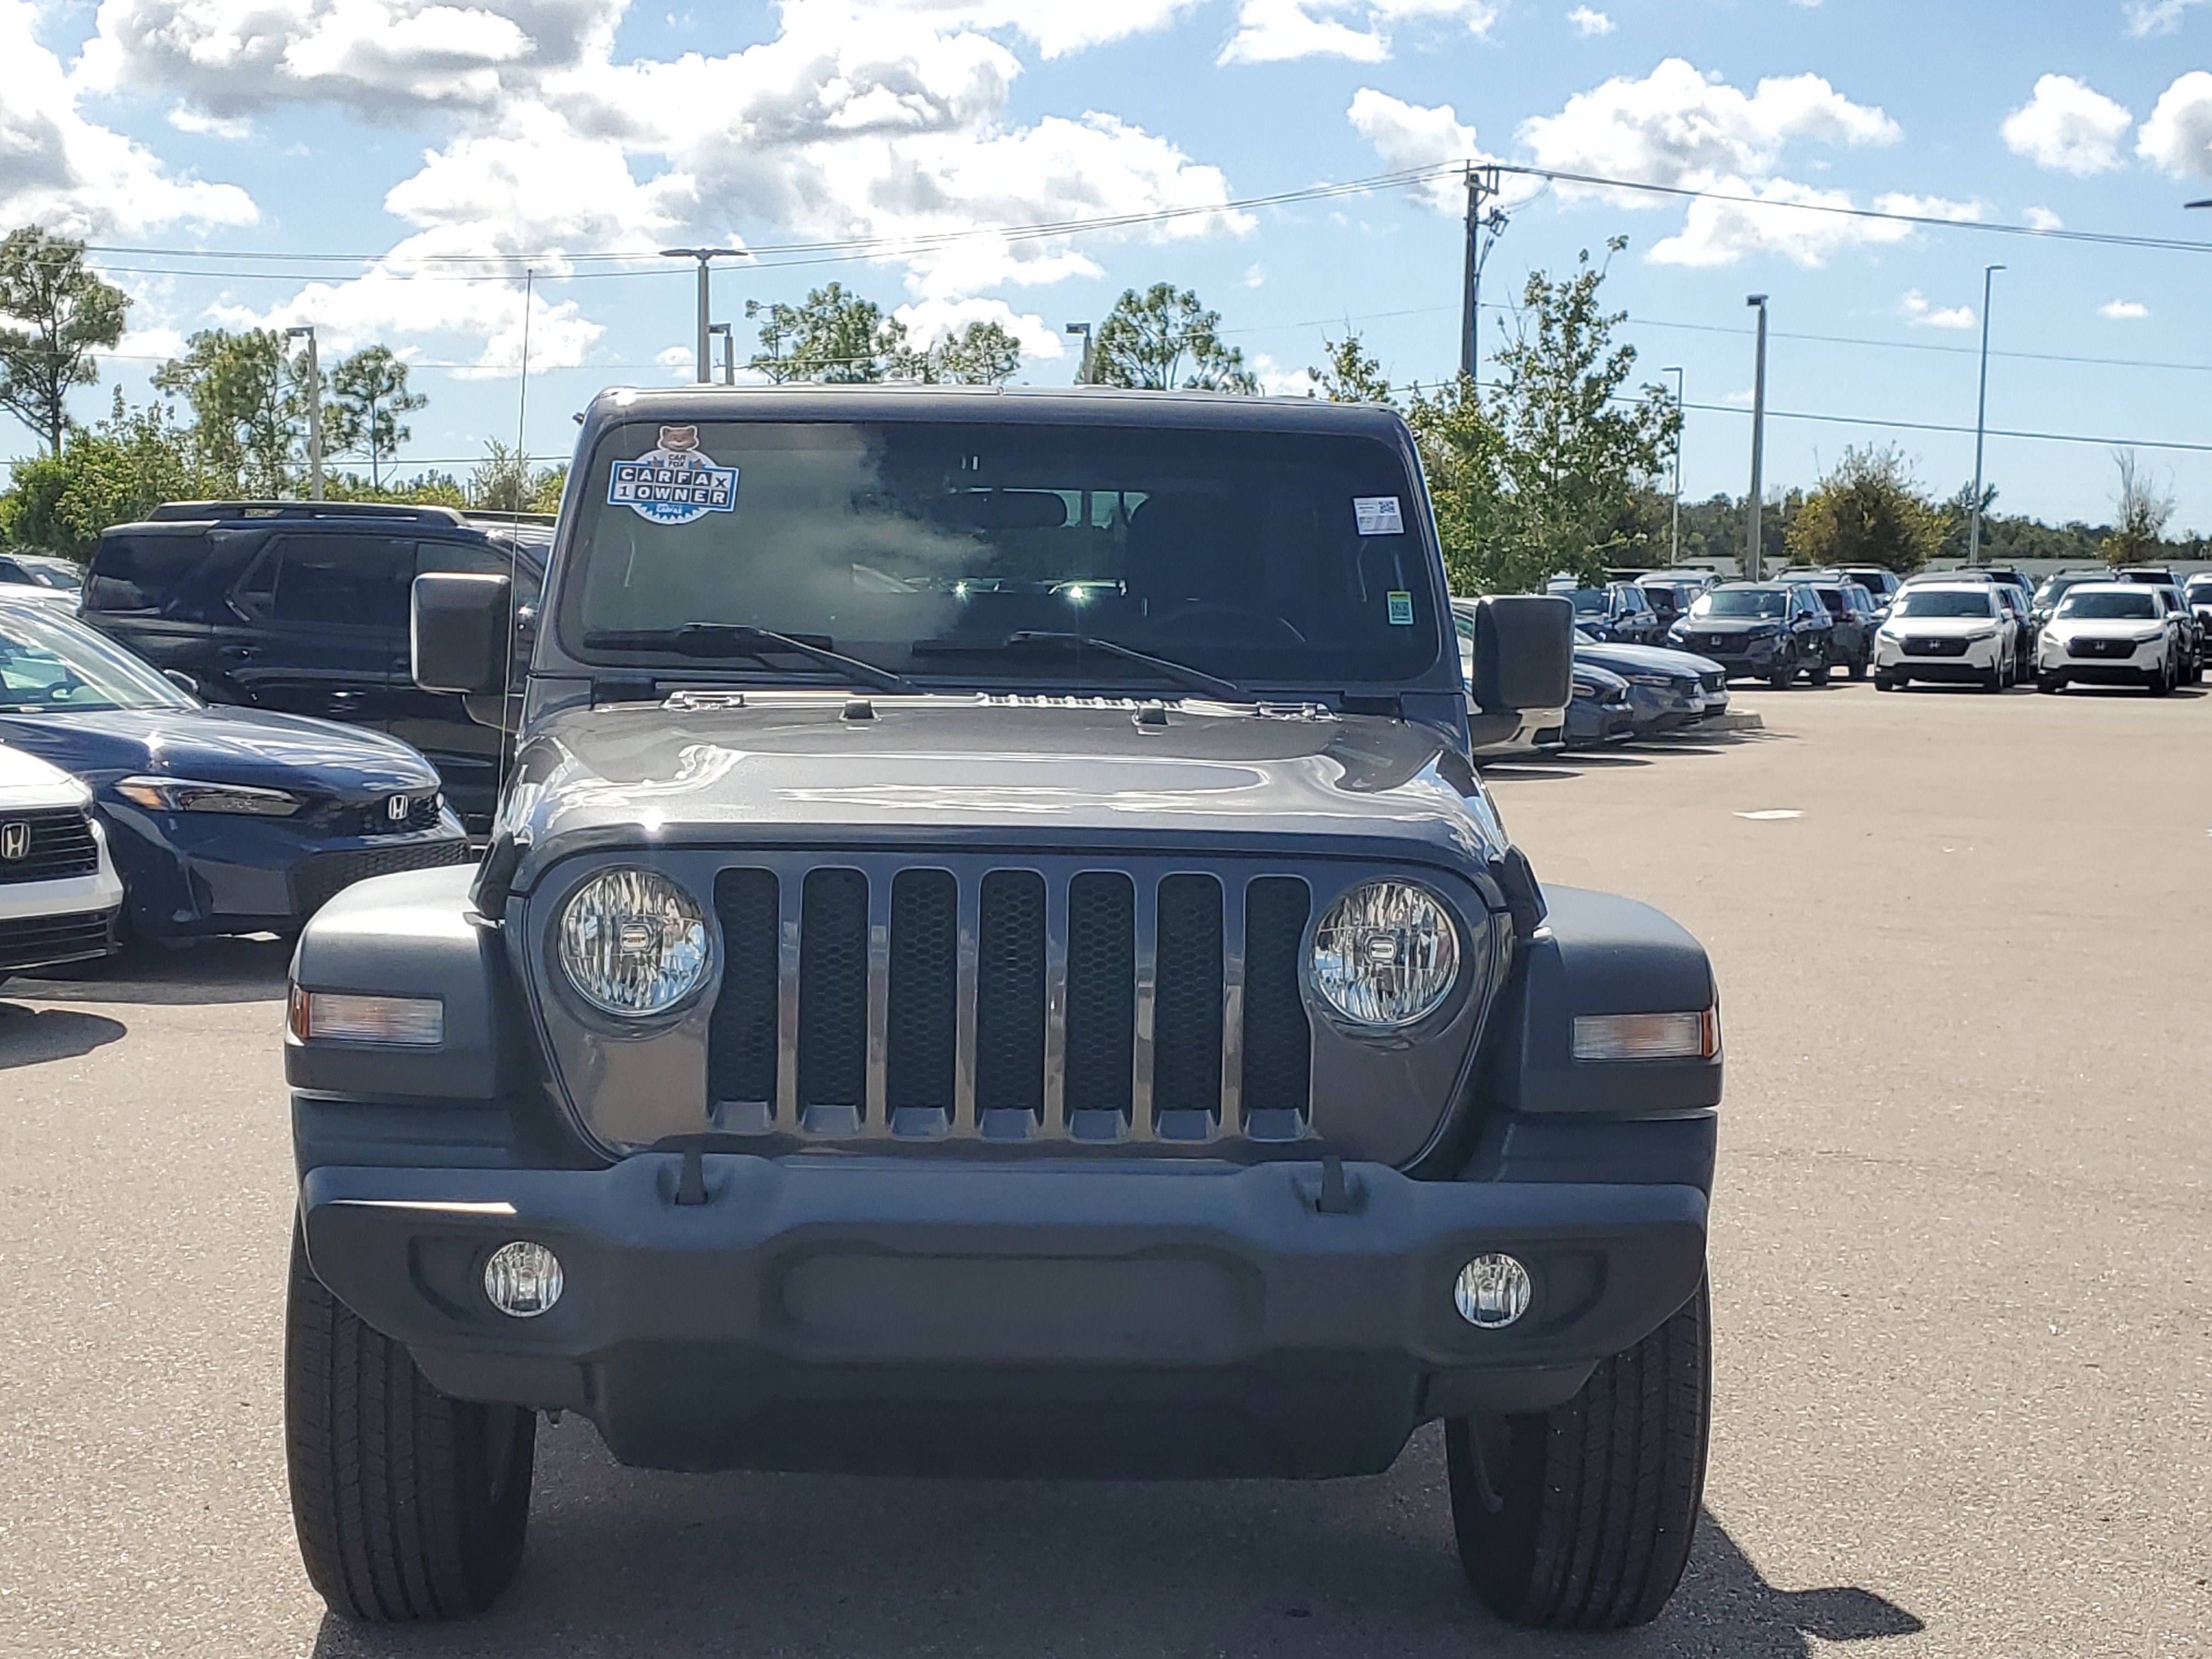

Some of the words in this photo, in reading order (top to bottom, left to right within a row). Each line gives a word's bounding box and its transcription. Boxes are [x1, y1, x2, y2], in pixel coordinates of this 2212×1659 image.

[620, 469, 727, 488] CARFAX
[618, 486, 629, 497] 1
[637, 486, 725, 504] OWNER
